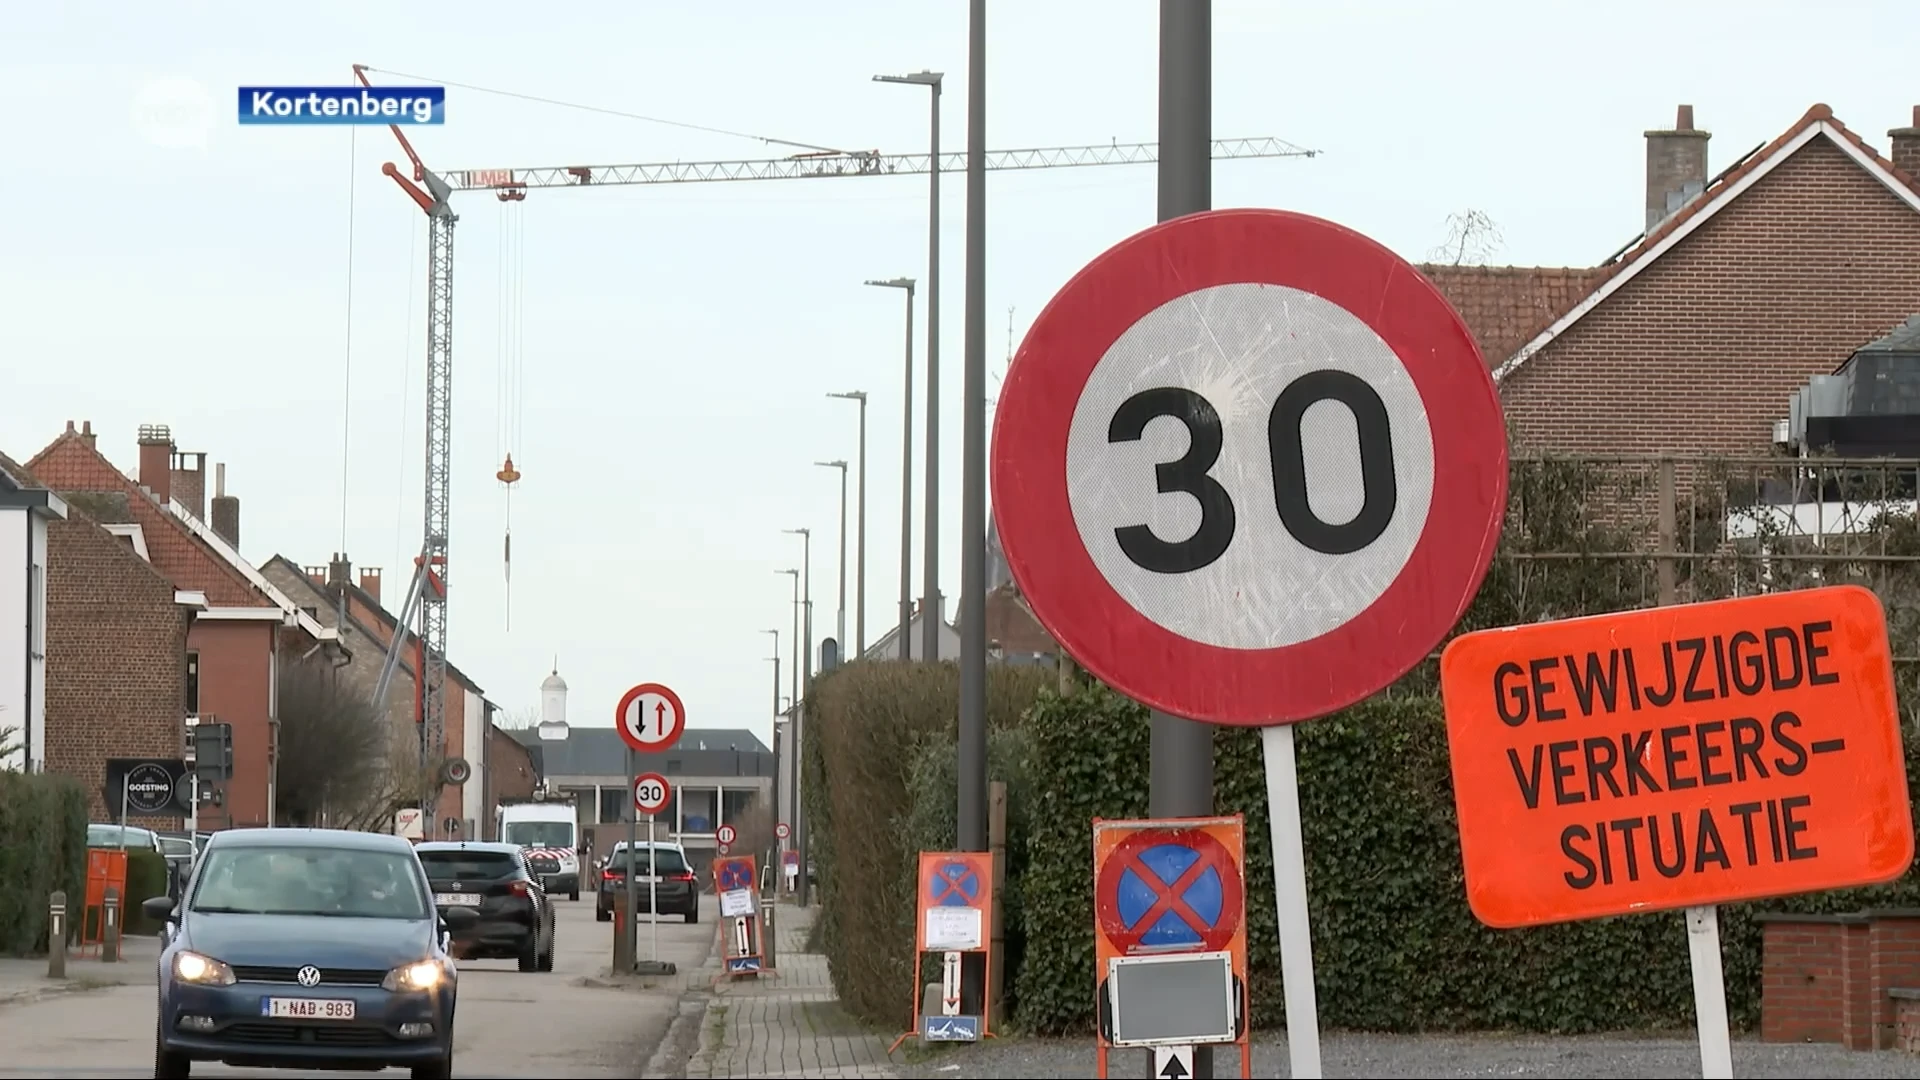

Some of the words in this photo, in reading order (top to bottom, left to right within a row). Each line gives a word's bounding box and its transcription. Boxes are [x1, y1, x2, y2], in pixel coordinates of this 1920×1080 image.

[1108, 369, 1397, 574] 30
[1493, 620, 1840, 727] GEWIJZIGDE
[128, 783, 169, 792] GOESTING
[639, 785, 662, 802] 30
[1506, 711, 1846, 809] VERKEERS-
[1560, 795, 1819, 890] SITUATIE
[298, 965, 321, 987] VW
